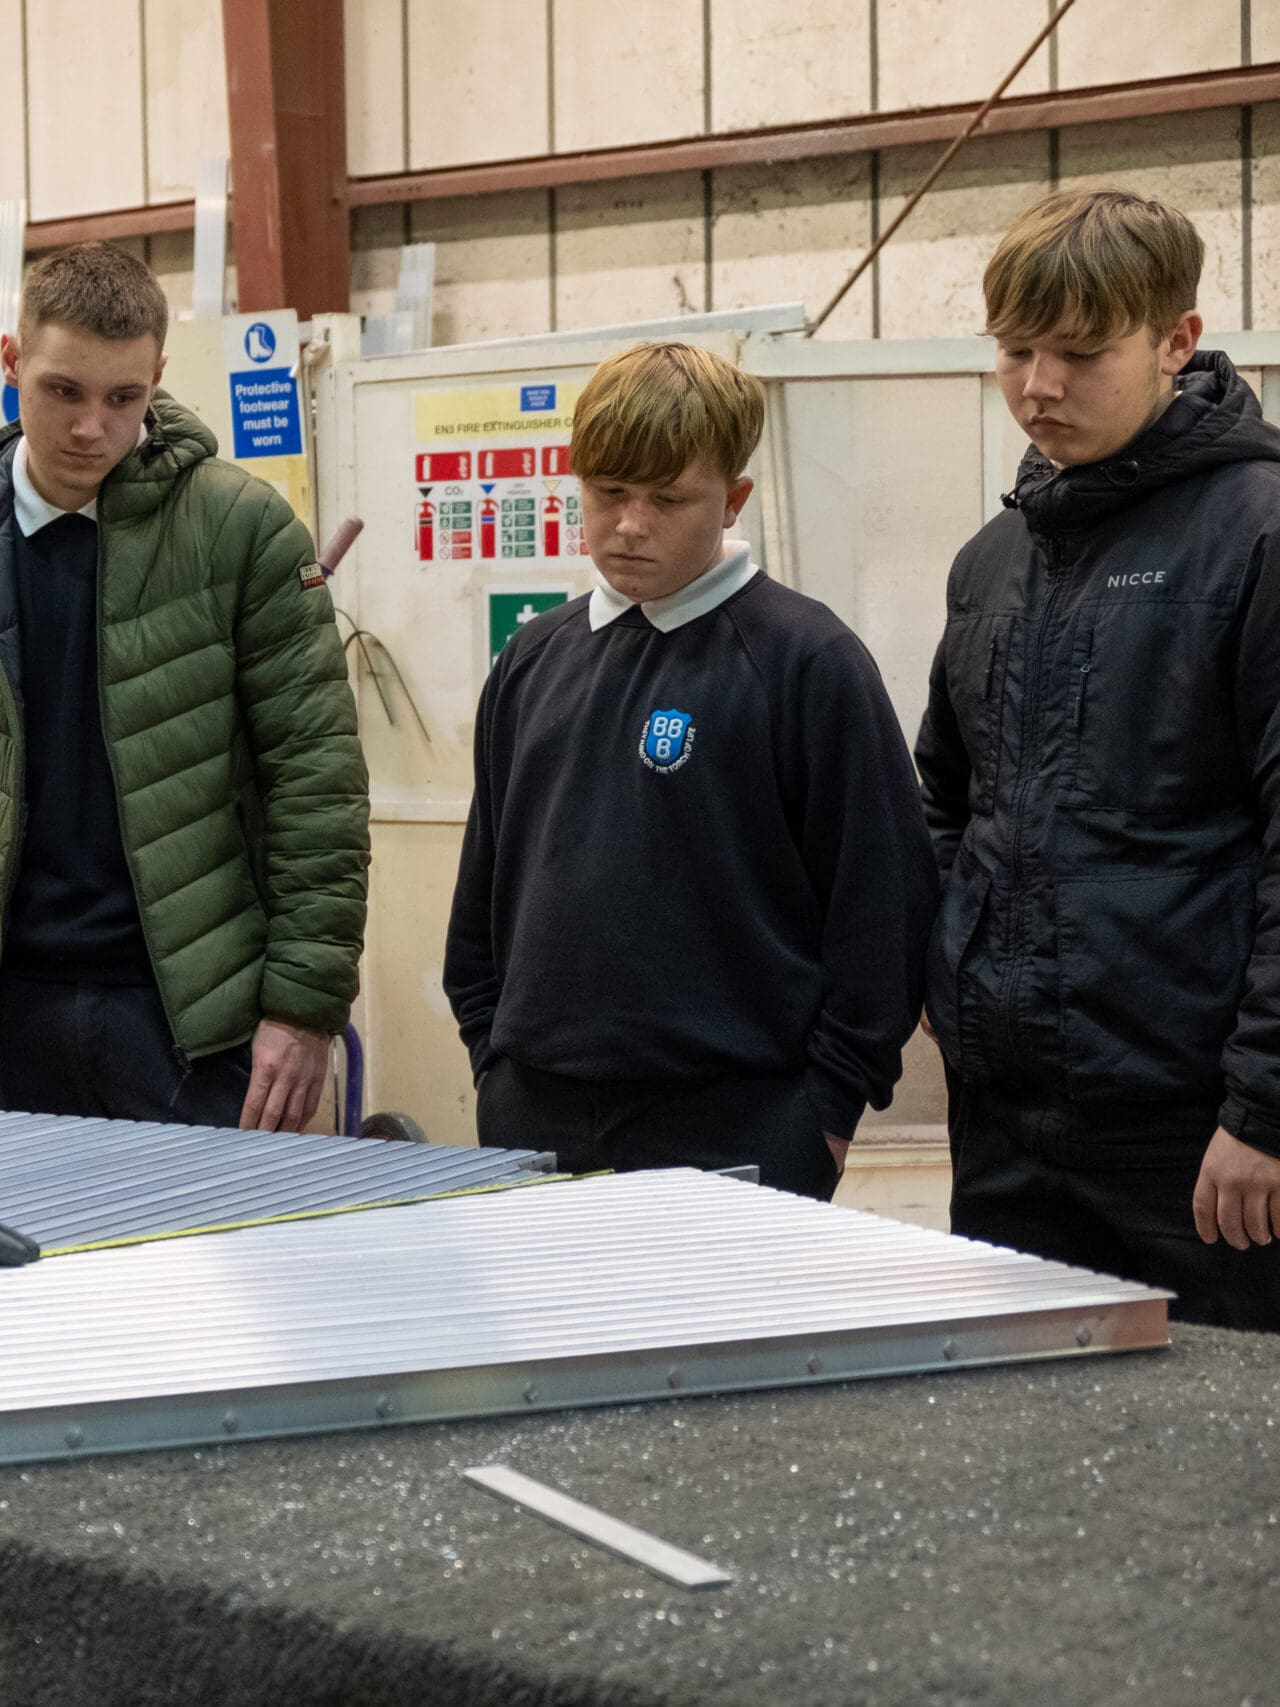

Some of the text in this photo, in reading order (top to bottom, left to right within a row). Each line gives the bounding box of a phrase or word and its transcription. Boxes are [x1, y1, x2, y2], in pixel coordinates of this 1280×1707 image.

[235, 381, 292, 397] Protective
[239, 399, 290, 414] footwear
[243, 416, 289, 431] must be
[435, 424, 454, 435] EN3
[458, 423, 480, 433] FIRE
[483, 417, 561, 432] EXTINGUISHER
[252, 434, 282, 447] worn
[1107, 571, 1166, 588] NICCE
